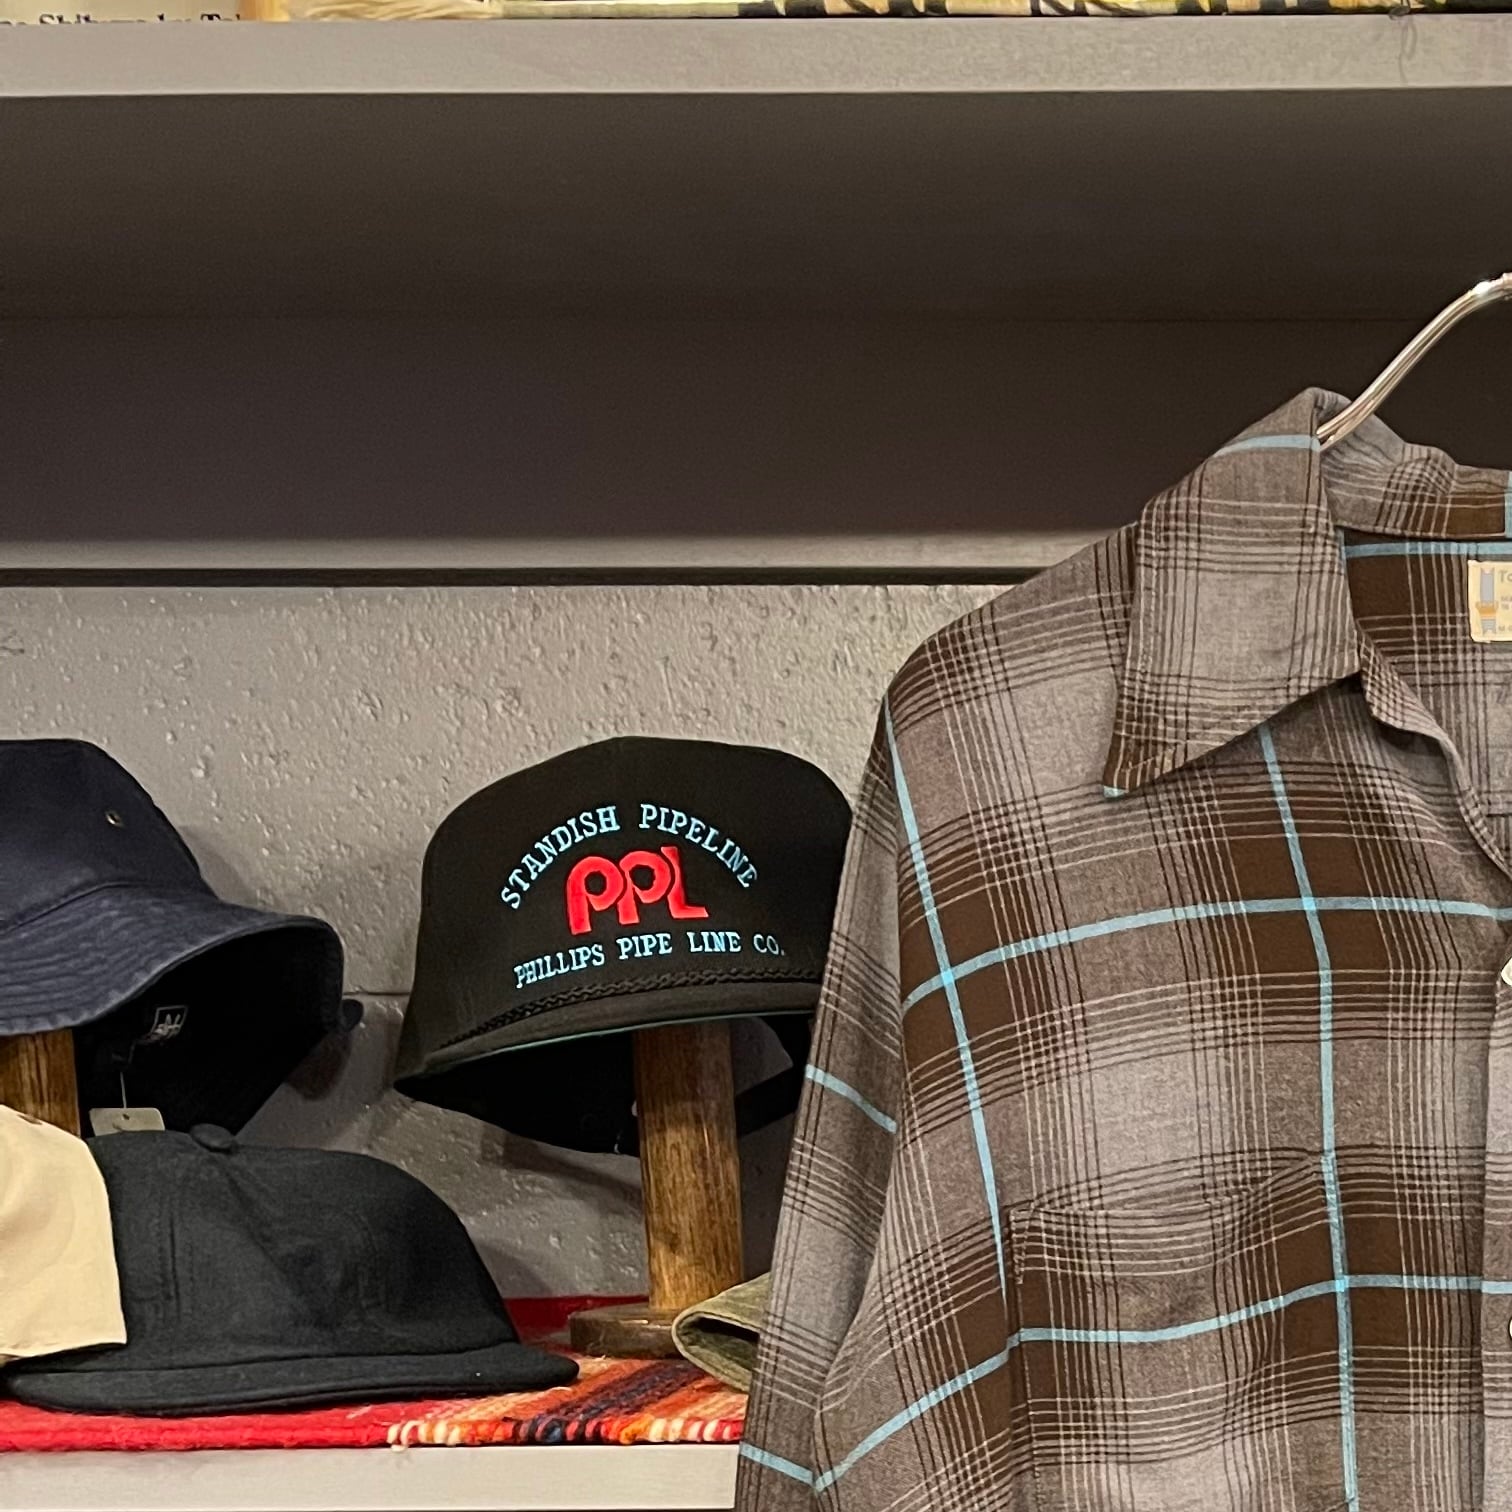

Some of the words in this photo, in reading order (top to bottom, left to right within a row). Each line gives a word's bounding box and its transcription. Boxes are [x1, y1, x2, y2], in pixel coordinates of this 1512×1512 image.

[501, 806, 620, 909] STANDISH
[639, 804, 758, 888] PIPELINE
[566, 846, 709, 935] PPL
[514, 944, 605, 988] PHILLIPS
[616, 933, 673, 959] PIPE
[687, 931, 741, 953] LINE
[754, 934, 785, 956] CO.
